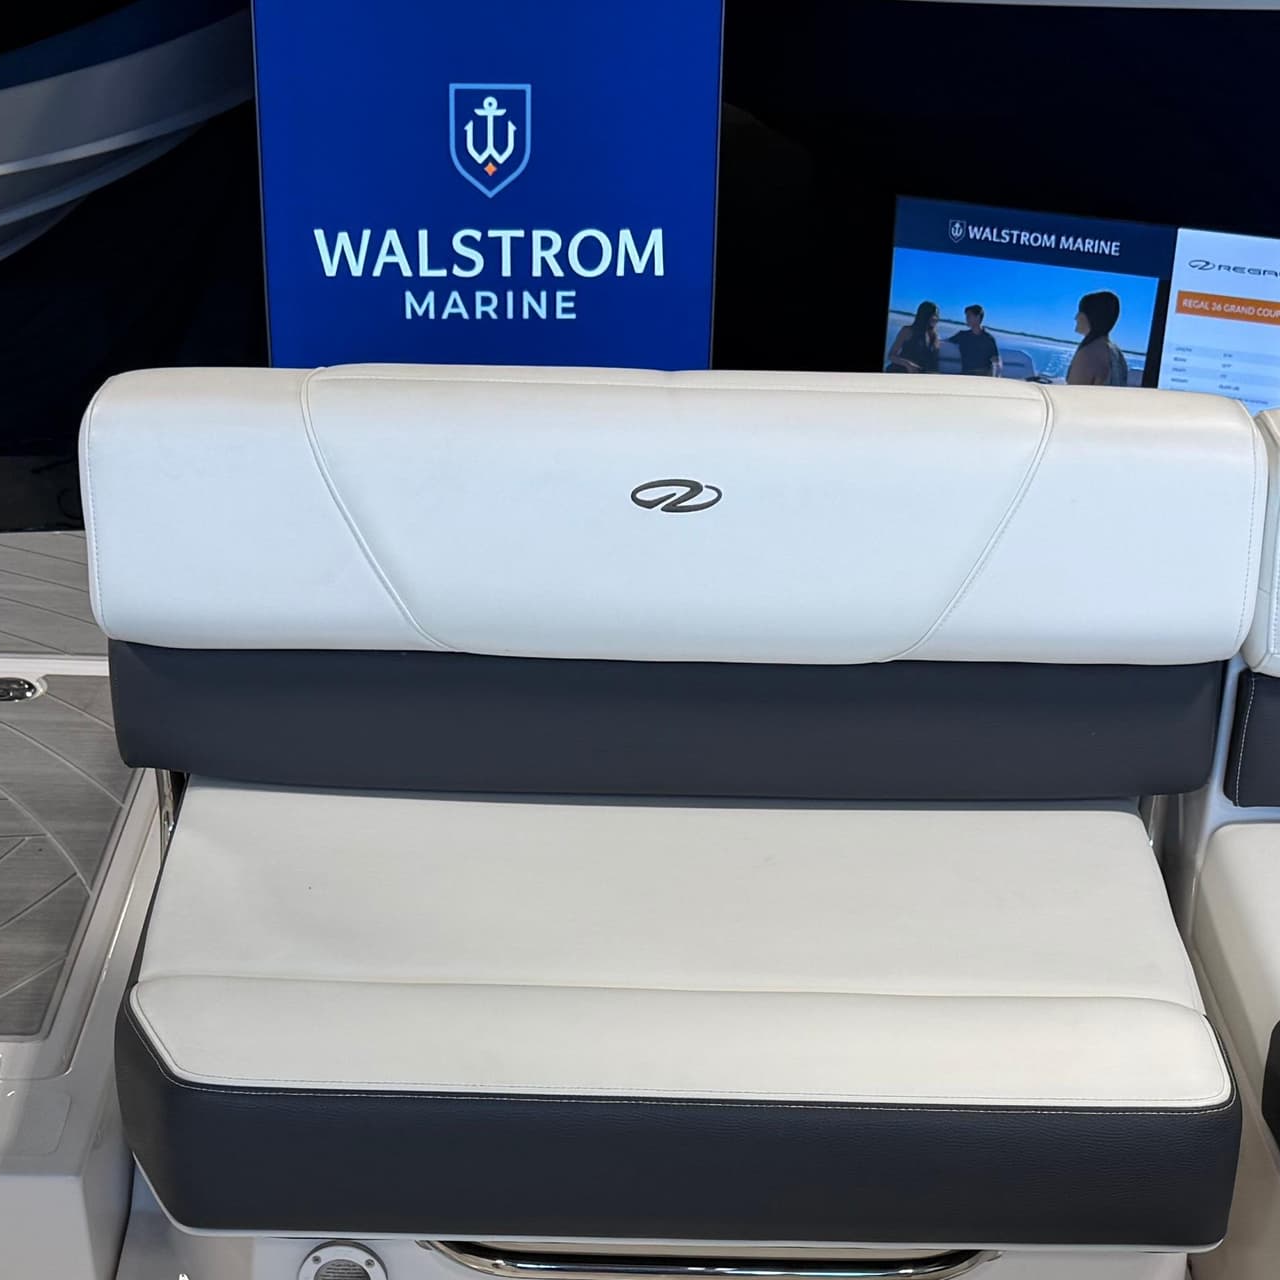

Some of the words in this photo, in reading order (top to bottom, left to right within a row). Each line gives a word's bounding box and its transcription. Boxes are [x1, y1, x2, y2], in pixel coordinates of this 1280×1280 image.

[313, 228, 665, 277] WALSTROM
[968, 225, 1056, 249] WALSTROM
[1059, 236, 1121, 256] MARINE
[404, 291, 577, 320] MARINE
[1183, 298, 1210, 311] REGAL
[1223, 303, 1255, 316] GRAND
